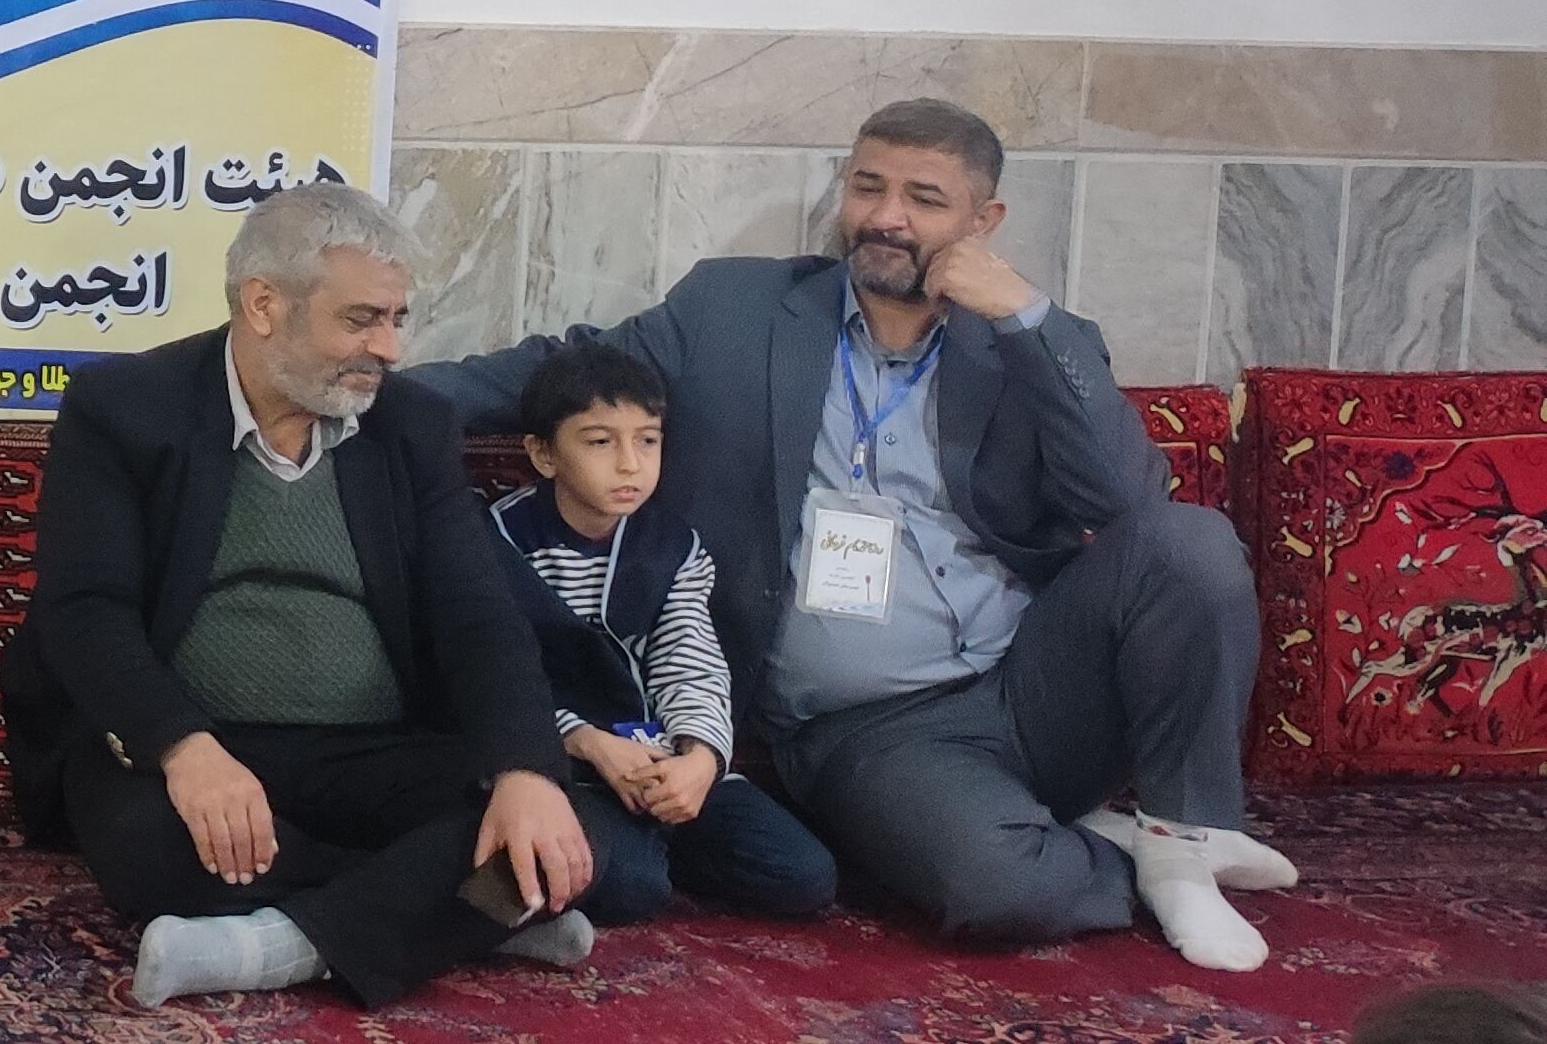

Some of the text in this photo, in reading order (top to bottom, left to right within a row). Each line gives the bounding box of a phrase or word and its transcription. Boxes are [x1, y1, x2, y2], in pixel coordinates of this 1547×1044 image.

[24, 145, 186, 224] انجمن
[3, 251, 167, 331] انجمن
[22, 376, 35, 398] و
